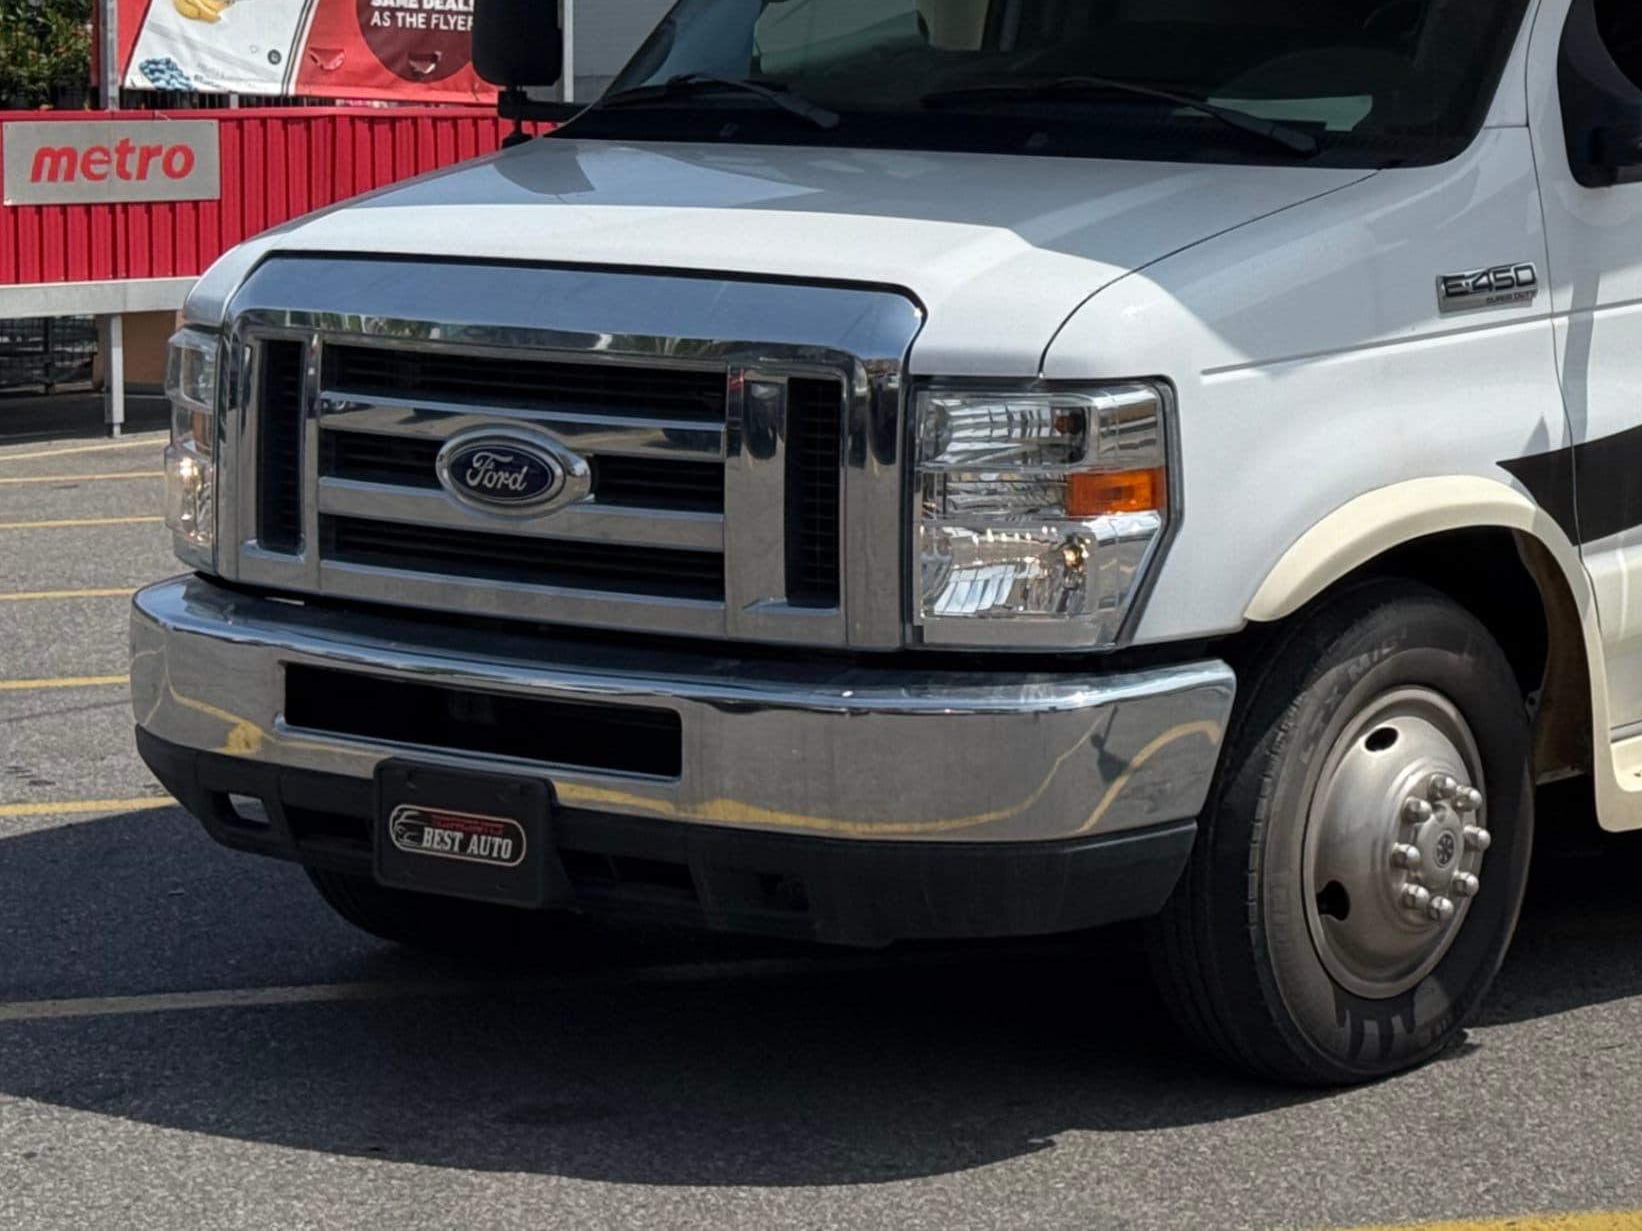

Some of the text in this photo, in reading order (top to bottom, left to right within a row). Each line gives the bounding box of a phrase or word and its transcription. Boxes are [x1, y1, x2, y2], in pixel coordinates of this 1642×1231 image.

[370, 11, 391, 26] AS
[395, 12, 427, 28] THE
[30, 138, 195, 183] metro
[466, 451, 529, 491] Ford
[421, 827, 513, 859] BEST AUTO
